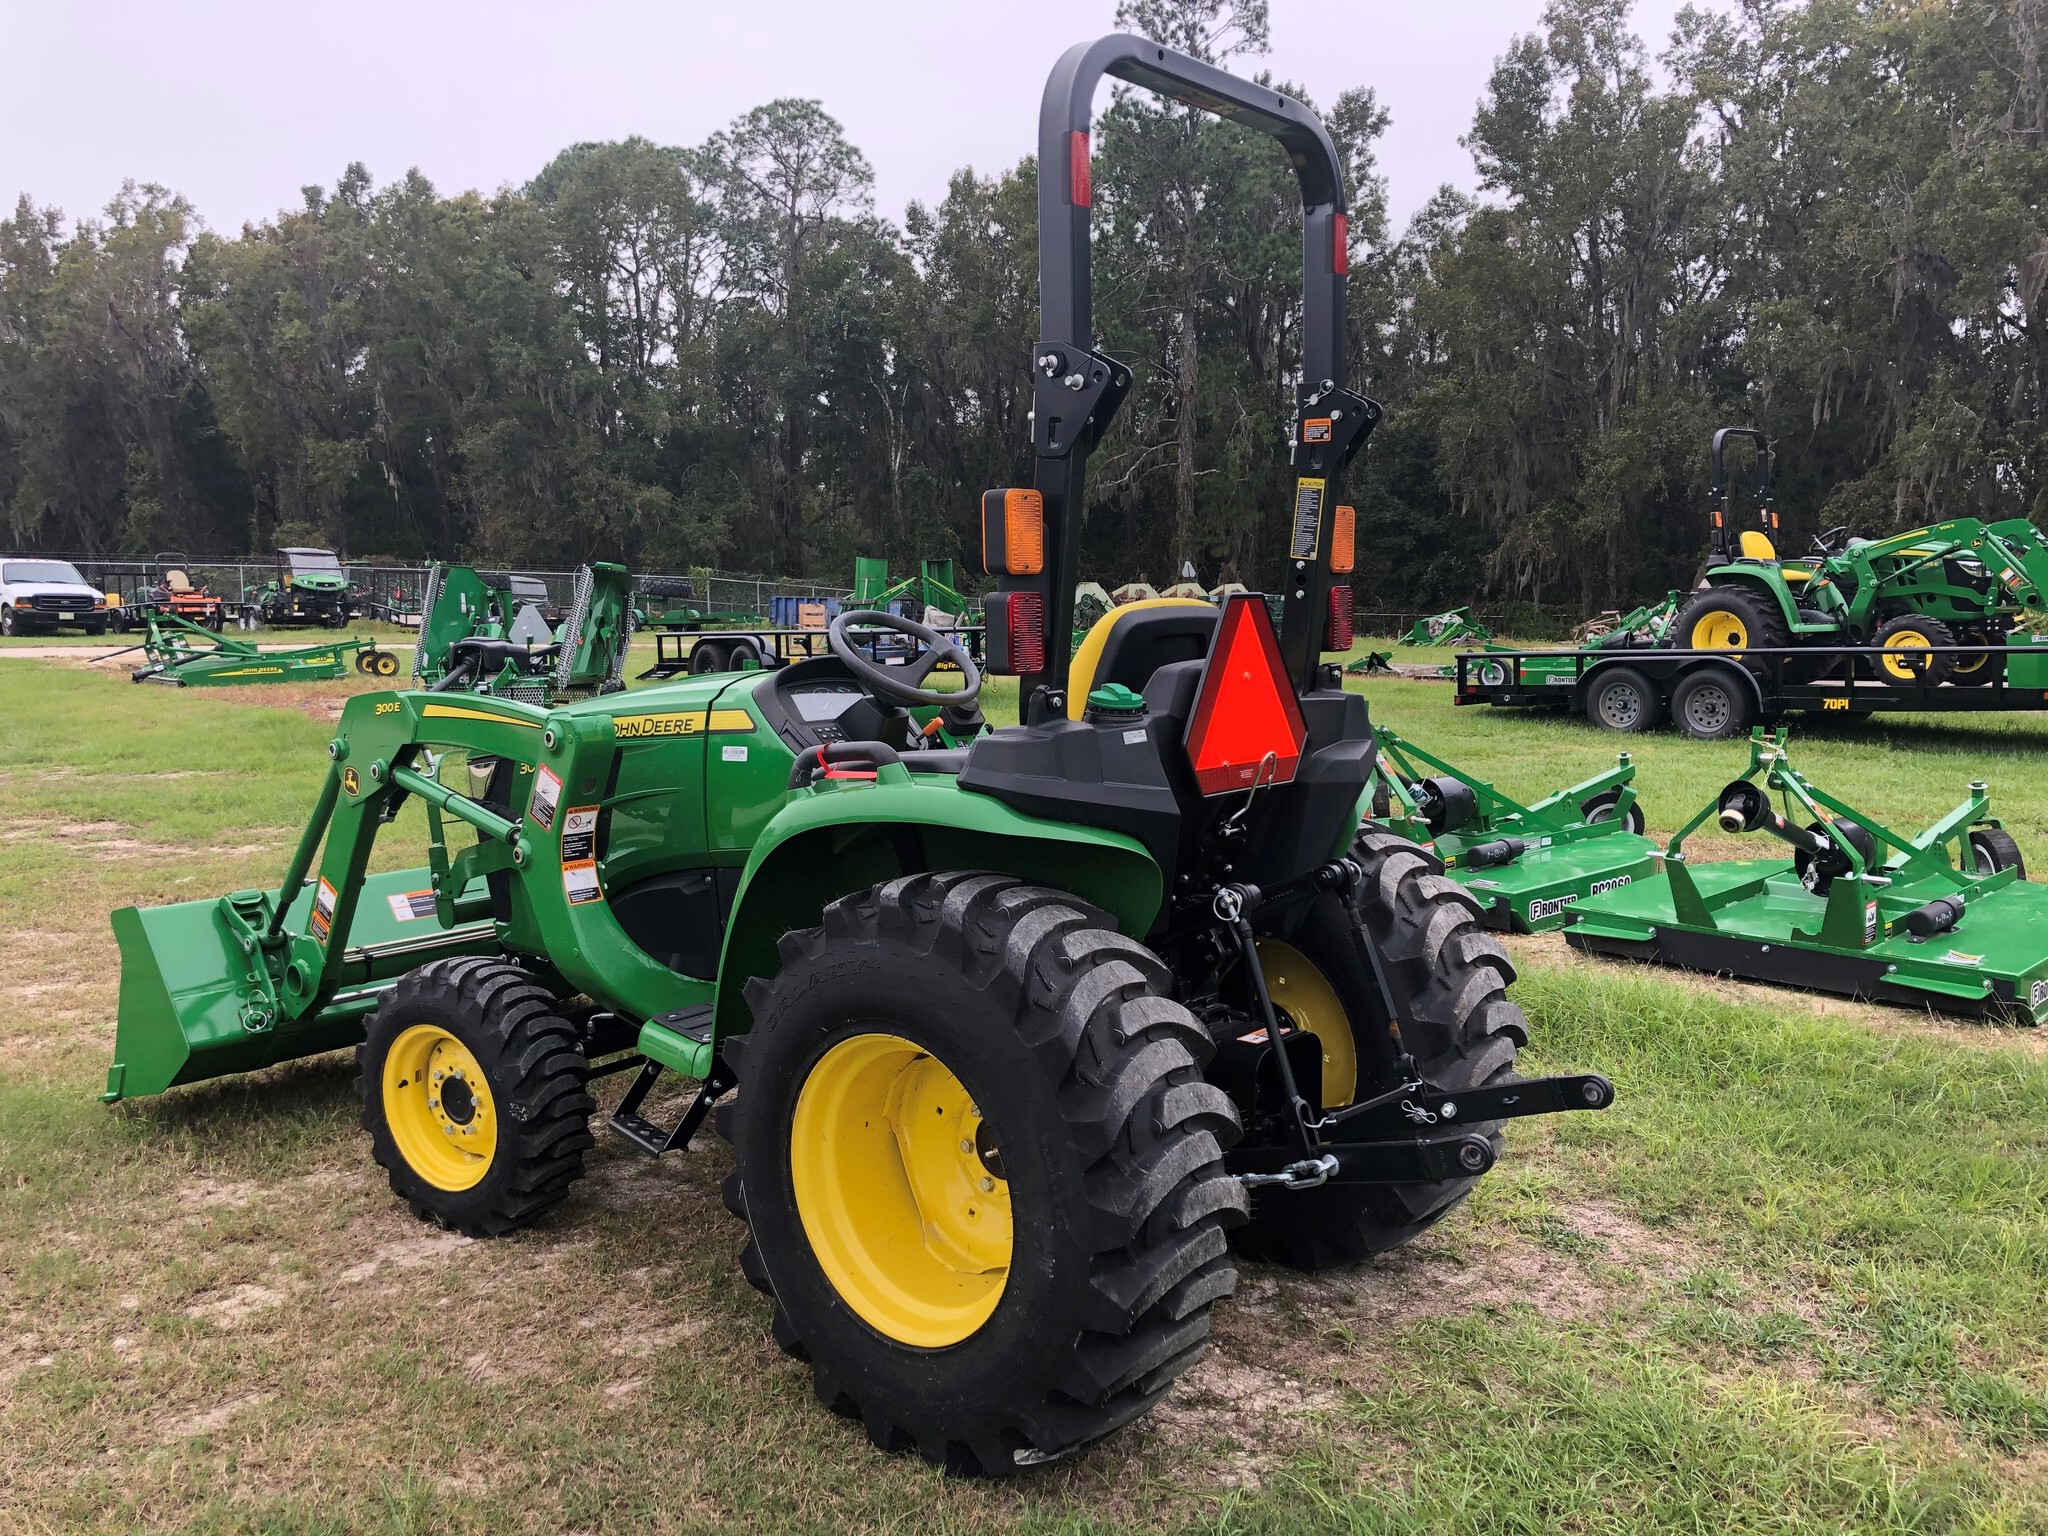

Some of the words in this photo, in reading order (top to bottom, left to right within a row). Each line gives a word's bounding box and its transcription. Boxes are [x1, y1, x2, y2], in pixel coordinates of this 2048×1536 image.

[375, 702, 401, 715] 300E
[1823, 698, 1849, 710] 70PI
[614, 722, 641, 736] OHN
[642, 718, 694, 734] DEERE
[573, 805, 599, 813] WARNING
[568, 862, 594, 870] WARNING
